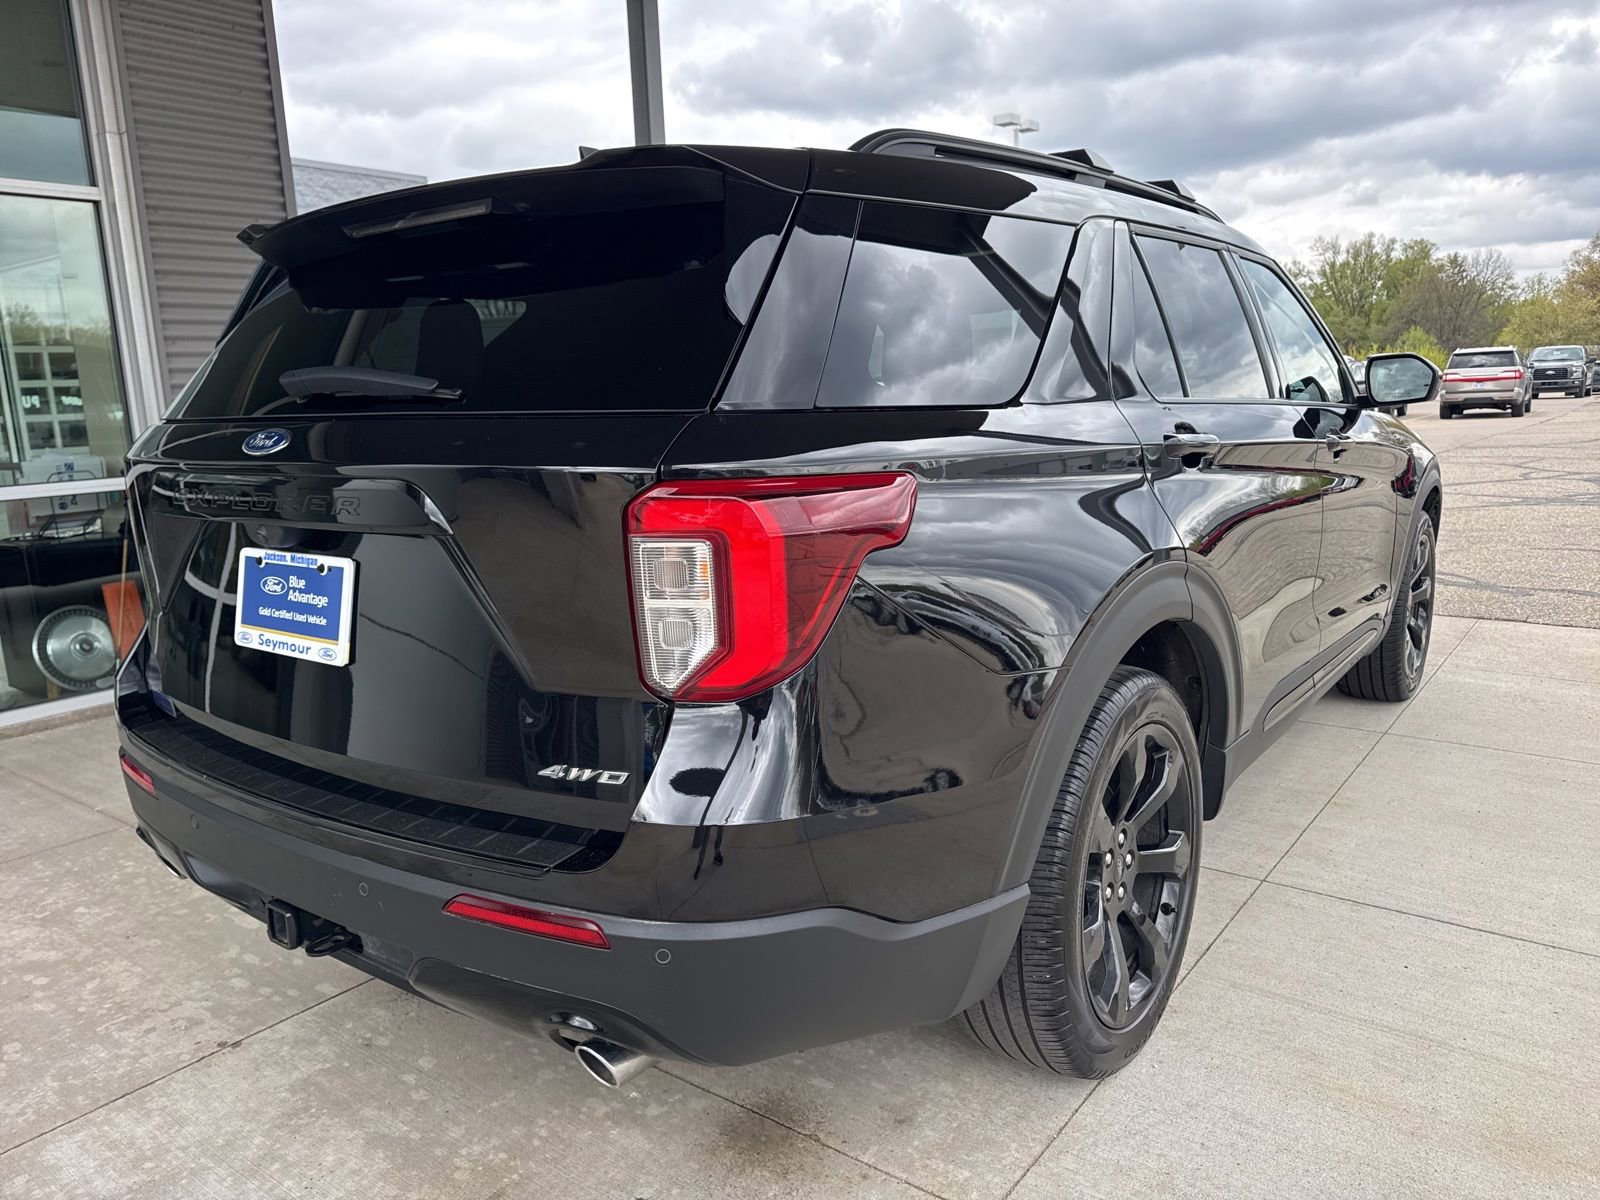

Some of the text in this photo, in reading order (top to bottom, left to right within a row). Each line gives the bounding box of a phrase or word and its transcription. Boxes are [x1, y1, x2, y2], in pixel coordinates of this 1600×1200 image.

[172, 487, 361, 516] EXPLORER
[290, 552, 318, 567] Michigan
[264, 578, 283, 593] Ford
[288, 575, 306, 589] Blue
[287, 589, 329, 608] Advantage
[258, 606, 328, 626] Gold Certified Used Vehicle
[258, 634, 311, 654] Seymour
[537, 764, 630, 785] 4WD
